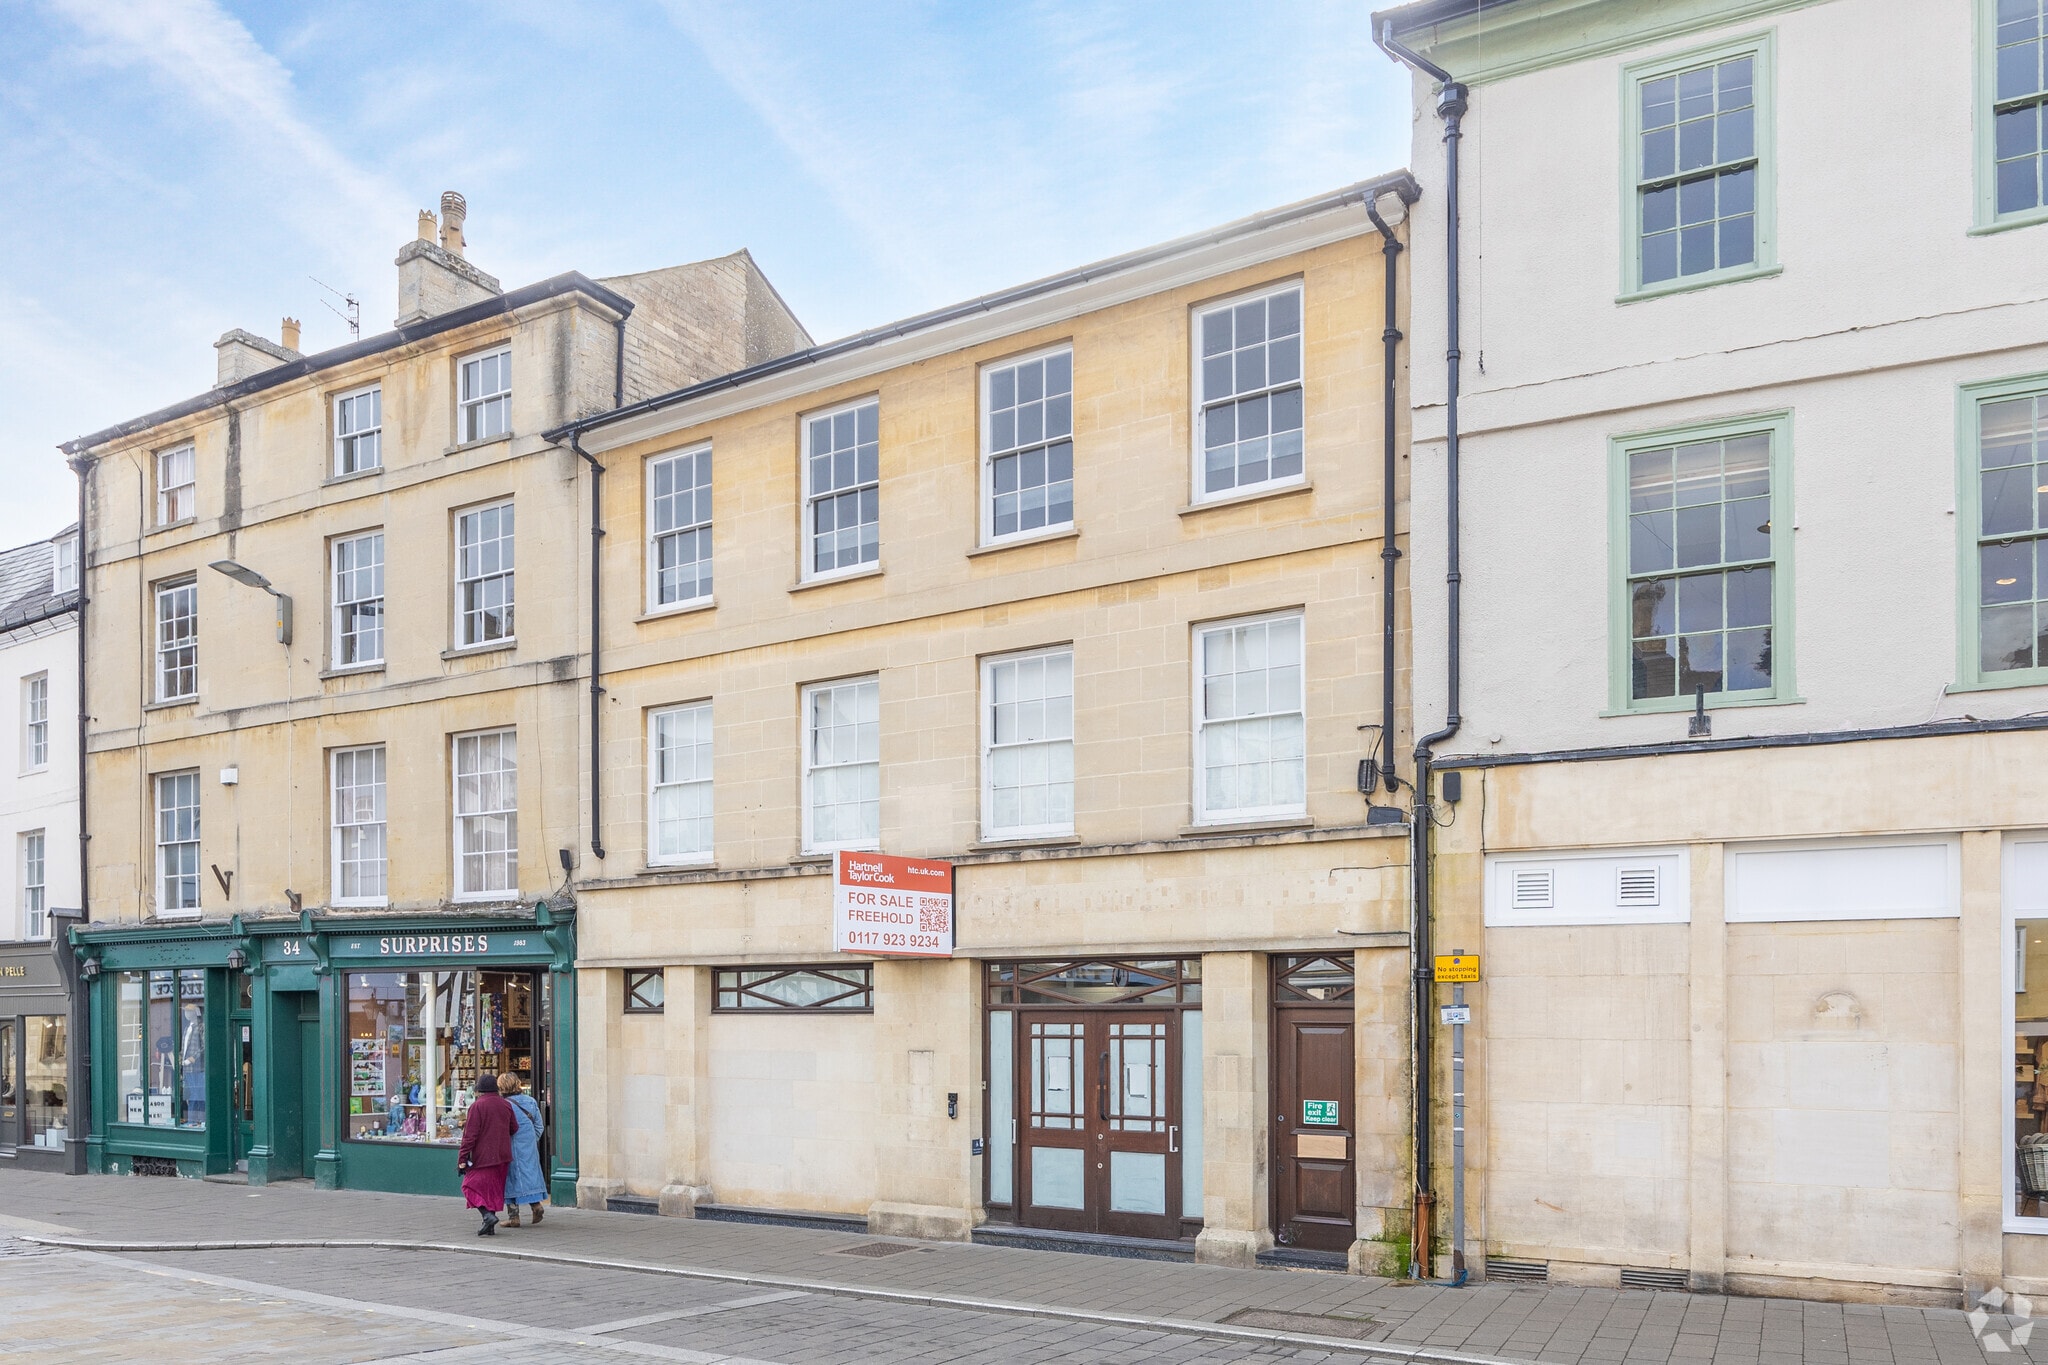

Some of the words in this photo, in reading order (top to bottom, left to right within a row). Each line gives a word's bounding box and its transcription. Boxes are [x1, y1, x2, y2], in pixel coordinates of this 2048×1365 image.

[849, 860, 883, 873] Hartnell
[907, 866, 945, 876] htc.uk.com
[848, 892, 876, 905] FOR
[880, 894, 914, 908] SALE
[848, 910, 914, 924] FREEHOLD
[380, 935, 489, 954] SURPRISES
[848, 931, 879, 944] 0117
[883, 933, 906, 946] 923
[910, 935, 939, 948] 9234
[283, 940, 300, 955] 34
[5, 966, 25, 977] PELLE
